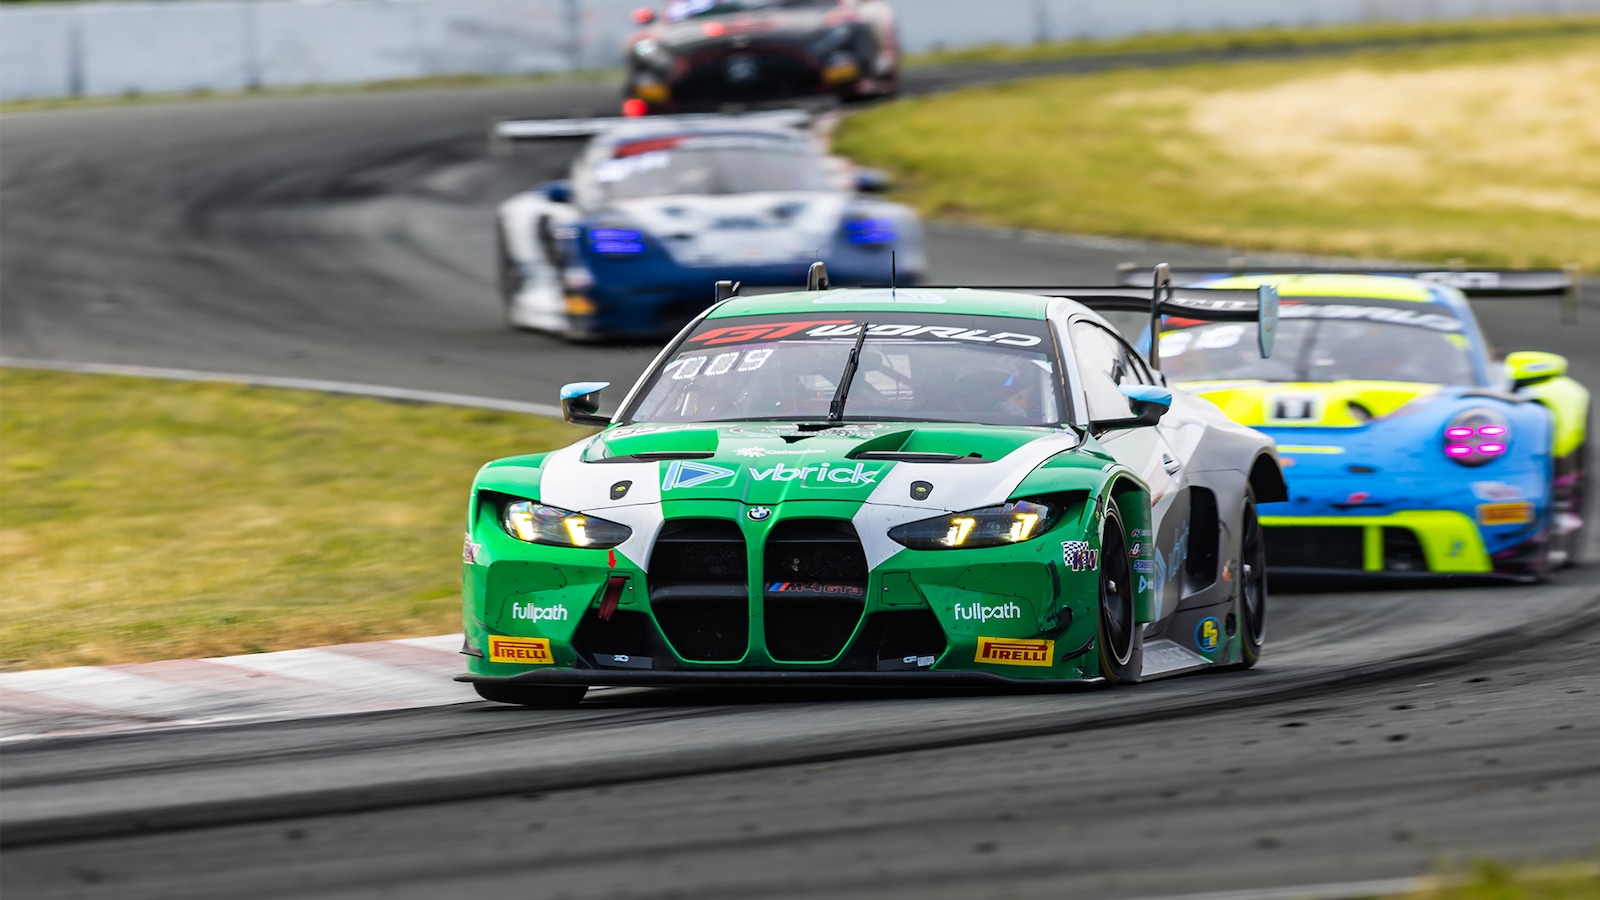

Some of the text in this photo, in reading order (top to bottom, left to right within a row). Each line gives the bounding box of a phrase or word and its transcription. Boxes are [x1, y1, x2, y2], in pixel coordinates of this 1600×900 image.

[806, 322, 1042, 347] WORLD
[749, 462, 878, 484] vbrick
[824, 584, 863, 595] GT3
[512, 602, 568, 623] fullpath
[954, 602, 1021, 623] fullpath
[493, 640, 546, 659] PIRELLI
[982, 642, 1048, 661] PIRELLI
